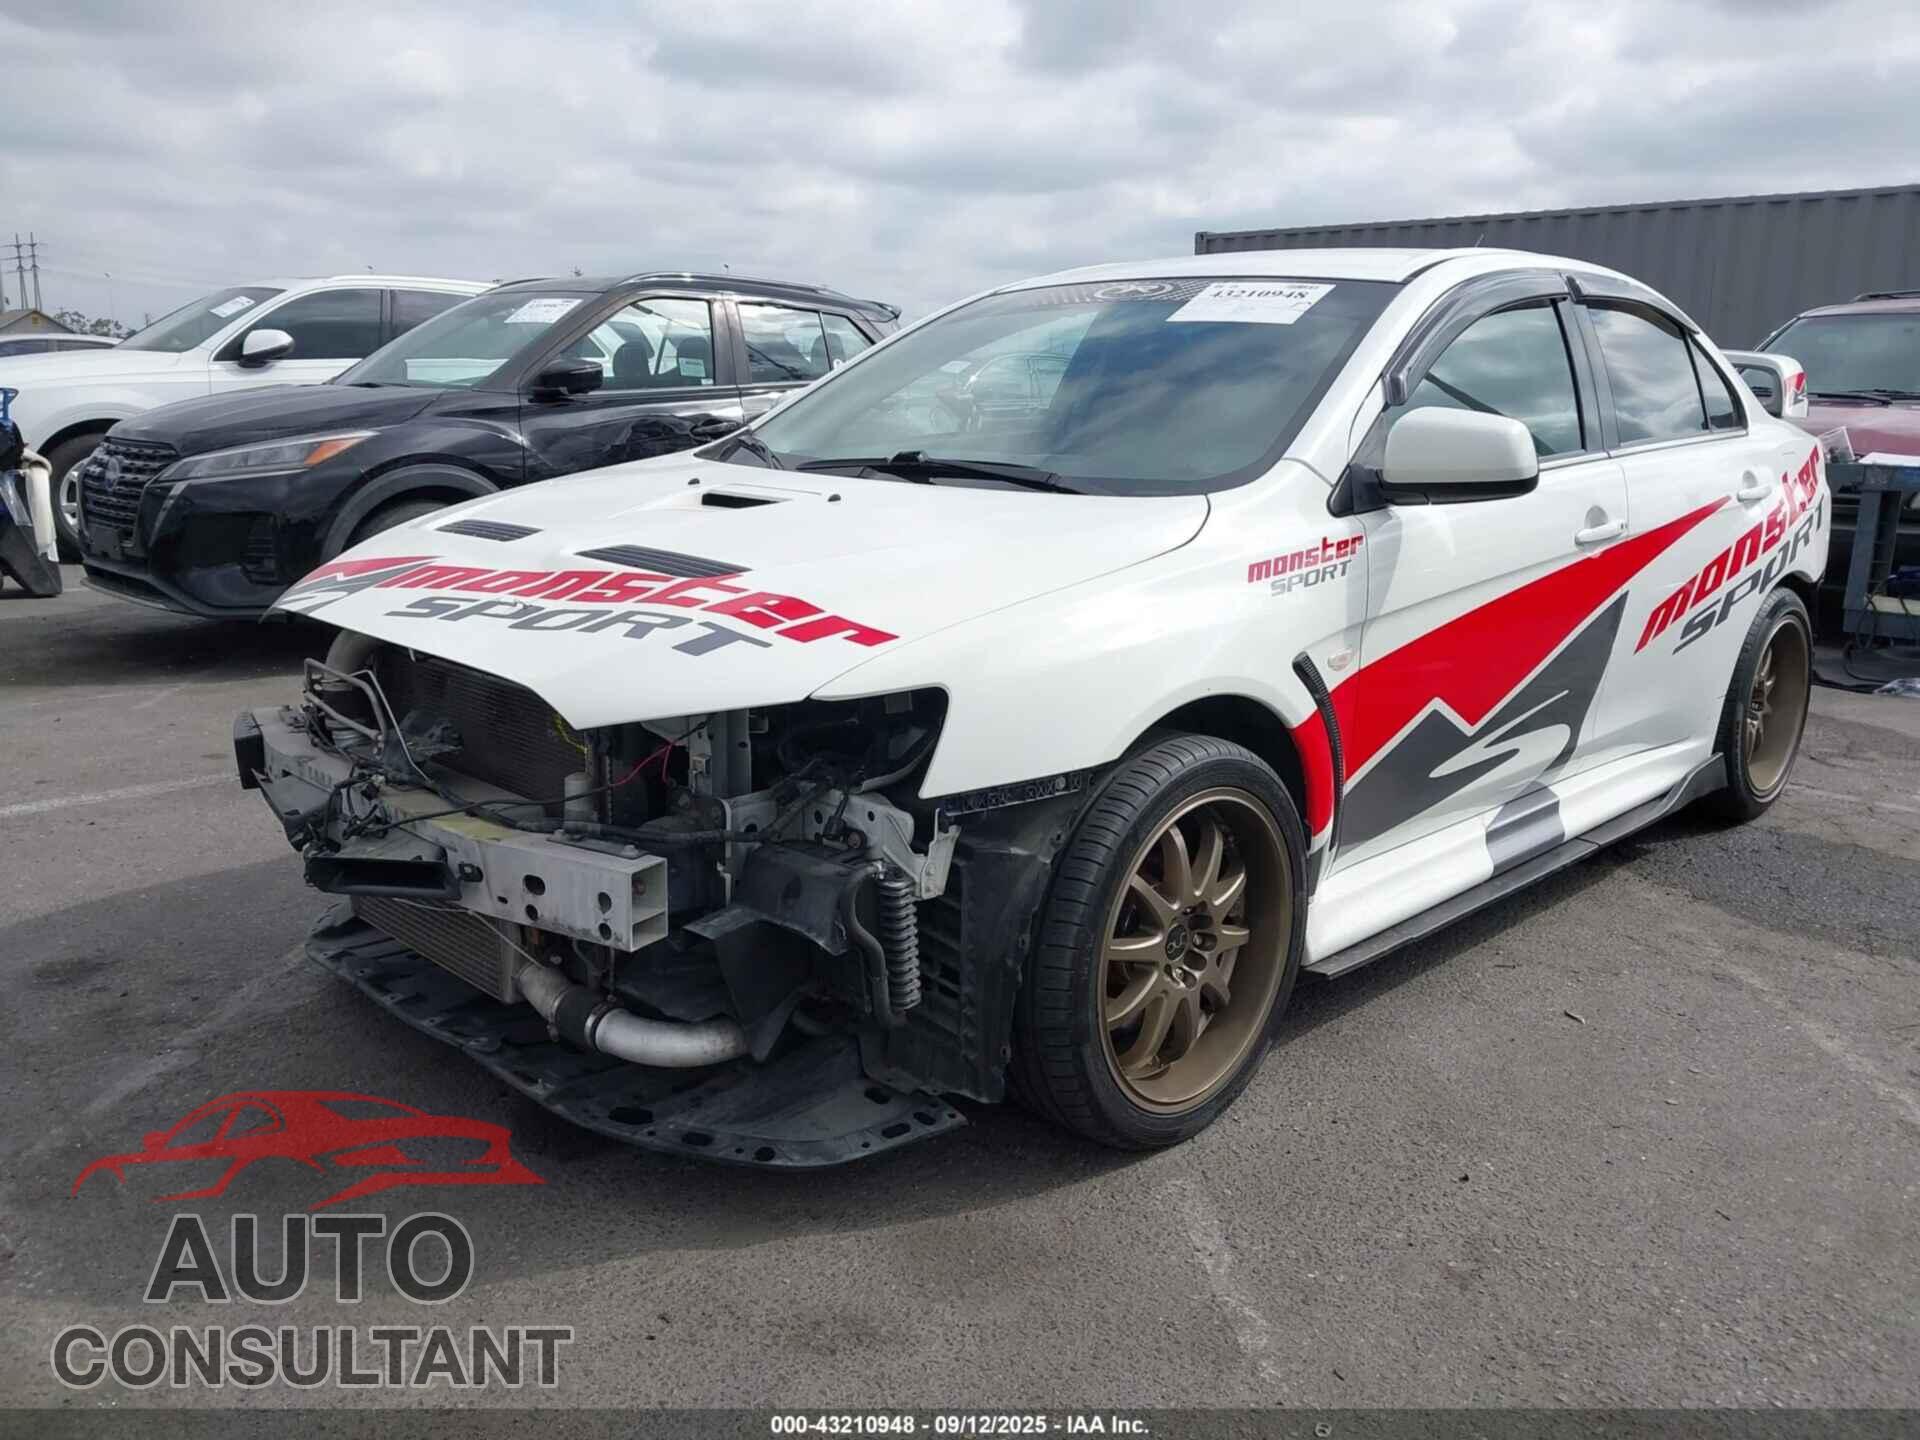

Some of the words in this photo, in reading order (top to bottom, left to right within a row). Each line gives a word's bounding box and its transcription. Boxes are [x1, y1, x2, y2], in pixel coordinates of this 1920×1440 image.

[1271, 560, 1353, 597] SPORT
[1672, 494, 1835, 655] SPORT
[384, 597, 773, 656] SPORT
